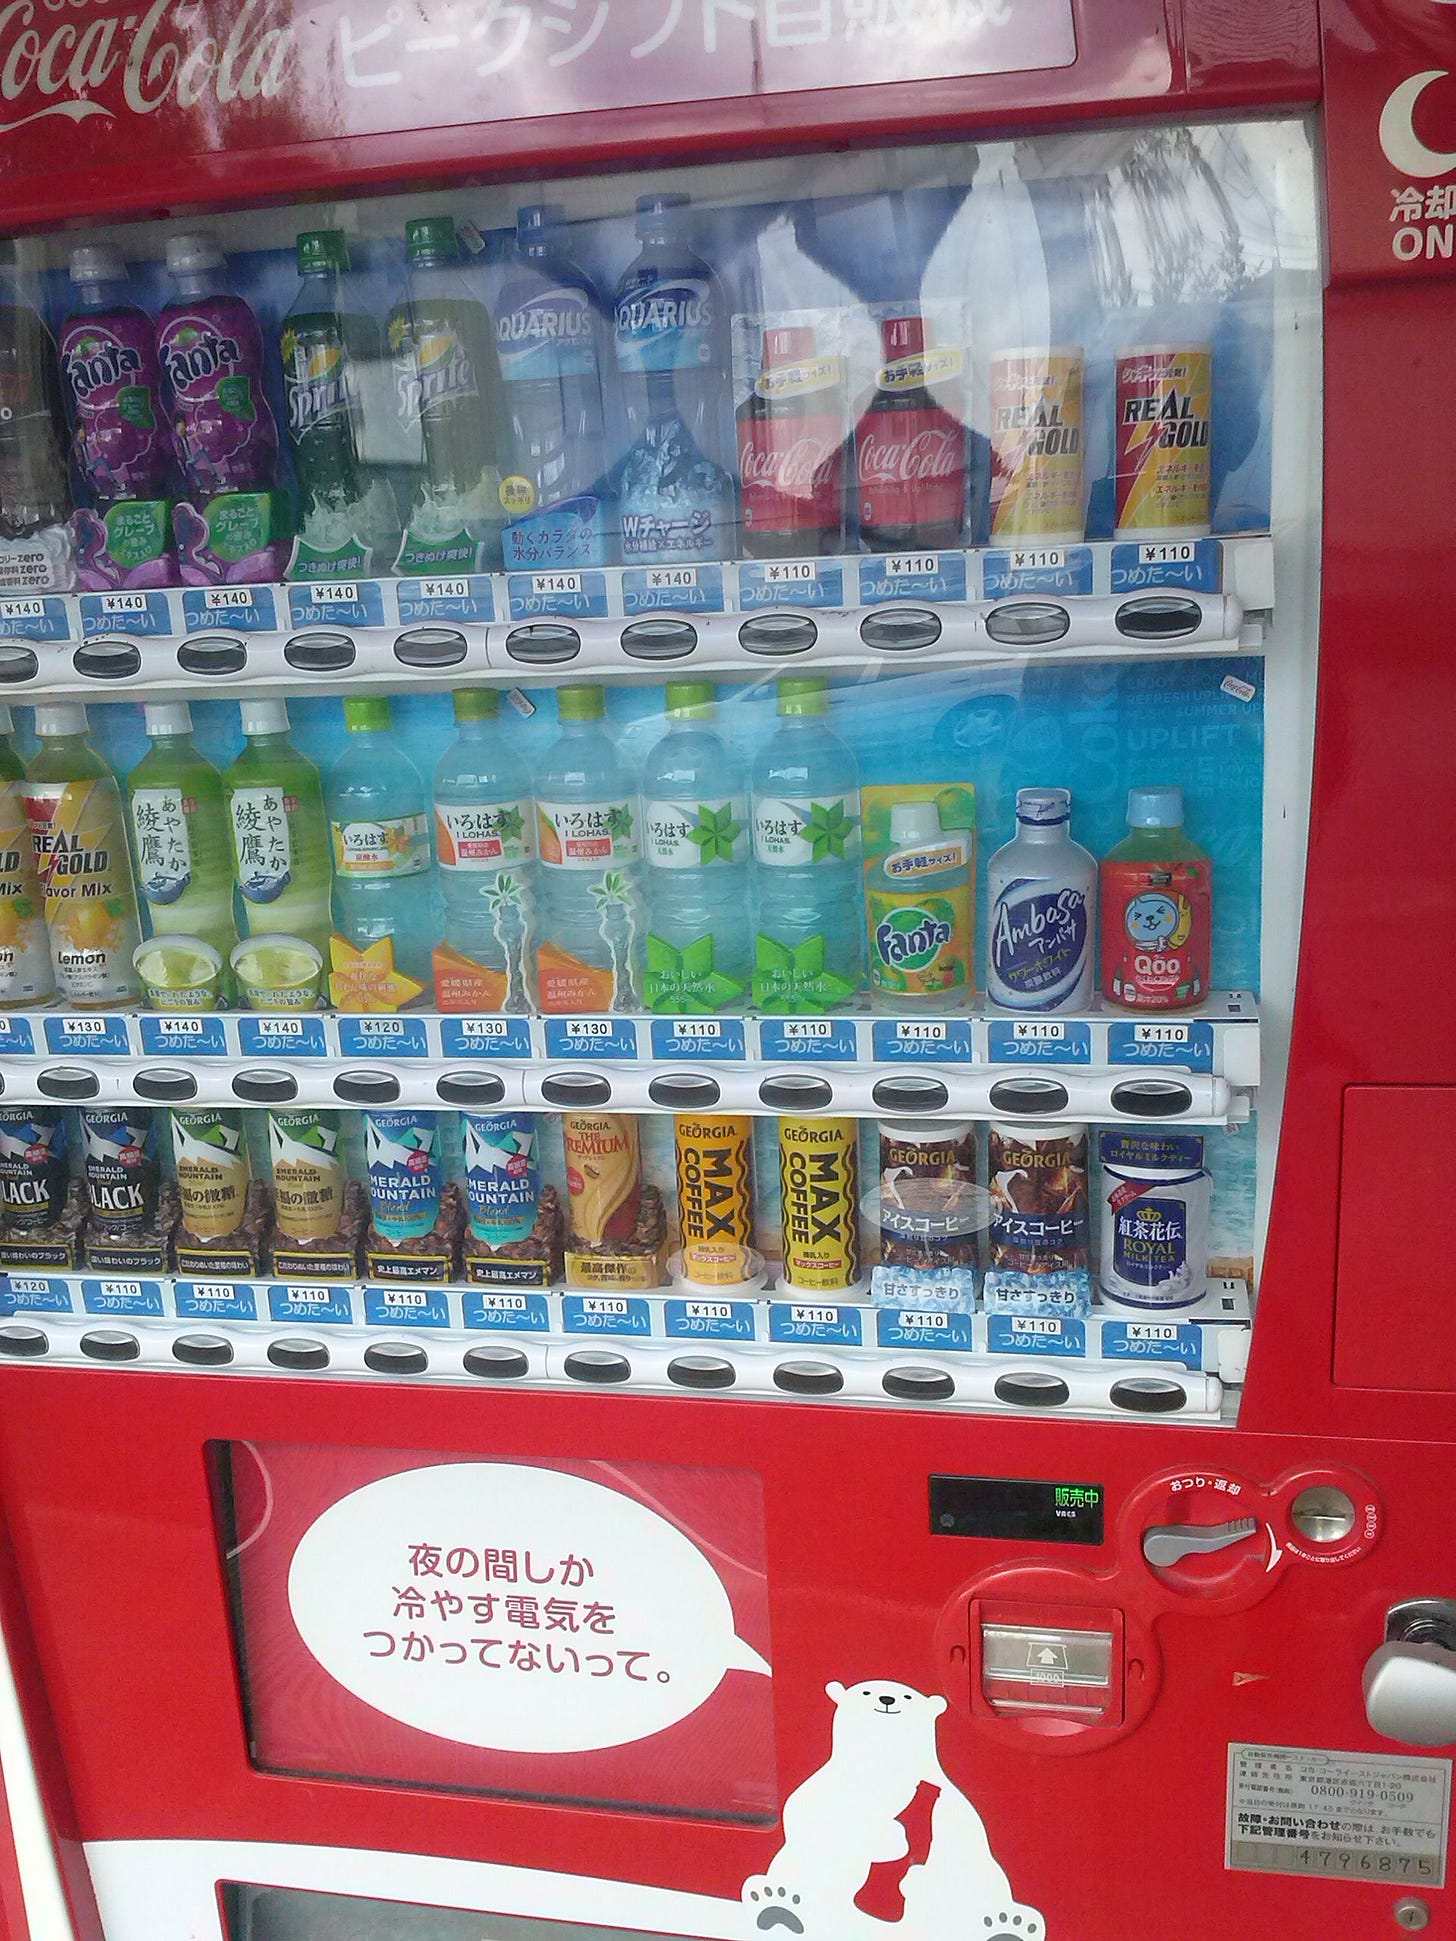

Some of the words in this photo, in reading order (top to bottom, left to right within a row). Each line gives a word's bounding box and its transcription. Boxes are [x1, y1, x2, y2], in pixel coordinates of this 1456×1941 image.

[1391, 223, 1455, 262] ON
[998, 395, 1064, 430] REAL
[1123, 384, 1195, 426] REAL
[1027, 427, 1080, 457] GOLD
[1157, 420, 1208, 449] GOLD
[859, 429, 960, 482] Coca-Cola
[621, 510, 712, 539] Wチャージ
[511, 527, 592, 545] 動くカラダの
[513, 543, 592, 561] 水分バランス
[1014, 551, 1060, 567] ¥110
[1145, 545, 1191, 561] ¥110
[768, 564, 811, 580] ¥110
[891, 558, 935, 573] ¥110
[536, 577, 576, 590] ¥140
[651, 571, 692, 586] ¥140
[315, 587, 354, 600] ¥140
[425, 582, 465, 595] ¥140
[106, 597, 143, 609] ¥140
[210, 592, 248, 605] ¥140
[5, 602, 41, 615] ¥140
[32, 828, 84, 853] REAL
[136, 802, 165, 867] 綾鷹
[161, 795, 187, 872] あやたか
[235, 802, 266, 866] 綾鷹
[262, 794, 288, 871] あやたか
[56, 850, 109, 876] GOLD
[891, 851, 958, 875] お手軽サイズ!
[82, 882, 113, 898] Mix
[876, 919, 952, 967] Fanta
[1028, 919, 1078, 955] アンバサ
[1008, 947, 1072, 981] サワーホワイト
[1134, 955, 1182, 975] Qoo
[67, 1022, 102, 1032] ¥130
[164, 1022, 199, 1032] ¥140
[262, 1022, 299, 1034] ¥140
[364, 1021, 400, 1033] ¥120
[466, 1022, 503, 1034] ¥130
[571, 1023, 608, 1035] ¥130
[678, 1023, 716, 1036] ¥110
[788, 1024, 827, 1036] ¥110
[901, 1025, 942, 1039] ¥110
[1017, 1025, 1060, 1038] ¥110
[1140, 1027, 1185, 1041] ¥110
[85, 1109, 129, 1124] GEORGIA
[179, 1112, 223, 1127] GEORGIA
[277, 1112, 320, 1128] GEORGIA
[375, 1114, 418, 1128] GEORGIA
[570, 1118, 611, 1131] GEORGIA
[474, 1118, 518, 1134] GEORGIA
[678, 1122, 737, 1140] GEORGIA
[578, 1131, 601, 1142] THE
[784, 1126, 844, 1144] GEORGIA
[889, 1147, 956, 1166] GEORGIA
[1002, 1148, 1072, 1168] GEORGIA
[684, 1146, 704, 1239] COFFEE
[702, 1147, 736, 1240] MAX
[789, 1151, 810, 1244] COFFEE
[808, 1152, 841, 1246] MAX
[882, 1208, 970, 1233] アイスコーヒー
[993, 1212, 1084, 1236] アイスコーヒー
[1118, 1215, 1182, 1241] 紅茶花伝
[1123, 1239, 1176, 1254] ROYAL
[794, 1259, 841, 1269] マックスコーヒー
[1123, 1251, 1150, 1262] MILK
[1152, 1253, 1176, 1263] TEA
[14, 1280, 46, 1292] ¥120
[104, 1283, 138, 1295] ¥110
[196, 1286, 230, 1299] ¥110
[883, 1280, 960, 1300] 甘さすっきり
[291, 1288, 325, 1302] ¥110
[387, 1292, 422, 1306] ¥110
[487, 1296, 523, 1309] ¥110
[996, 1287, 1075, 1304] 甘さすっきり
[588, 1300, 624, 1313] ¥110
[691, 1305, 728, 1317] ¥110
[796, 1309, 834, 1322] ¥110
[904, 1314, 944, 1327] ¥110
[1017, 1320, 1057, 1333] ¥110
[1132, 1325, 1172, 1339] ¥110
[1169, 1476, 1242, 1496] おつり・返却
[1055, 1487, 1099, 1508] 販売中
[407, 1543, 595, 1588] 夜の間しか
[391, 1586, 617, 1634] 冷やす電気を
[362, 1629, 672, 1685] つかってないって。
[1310, 1784, 1414, 1802] 0800-919-0509
